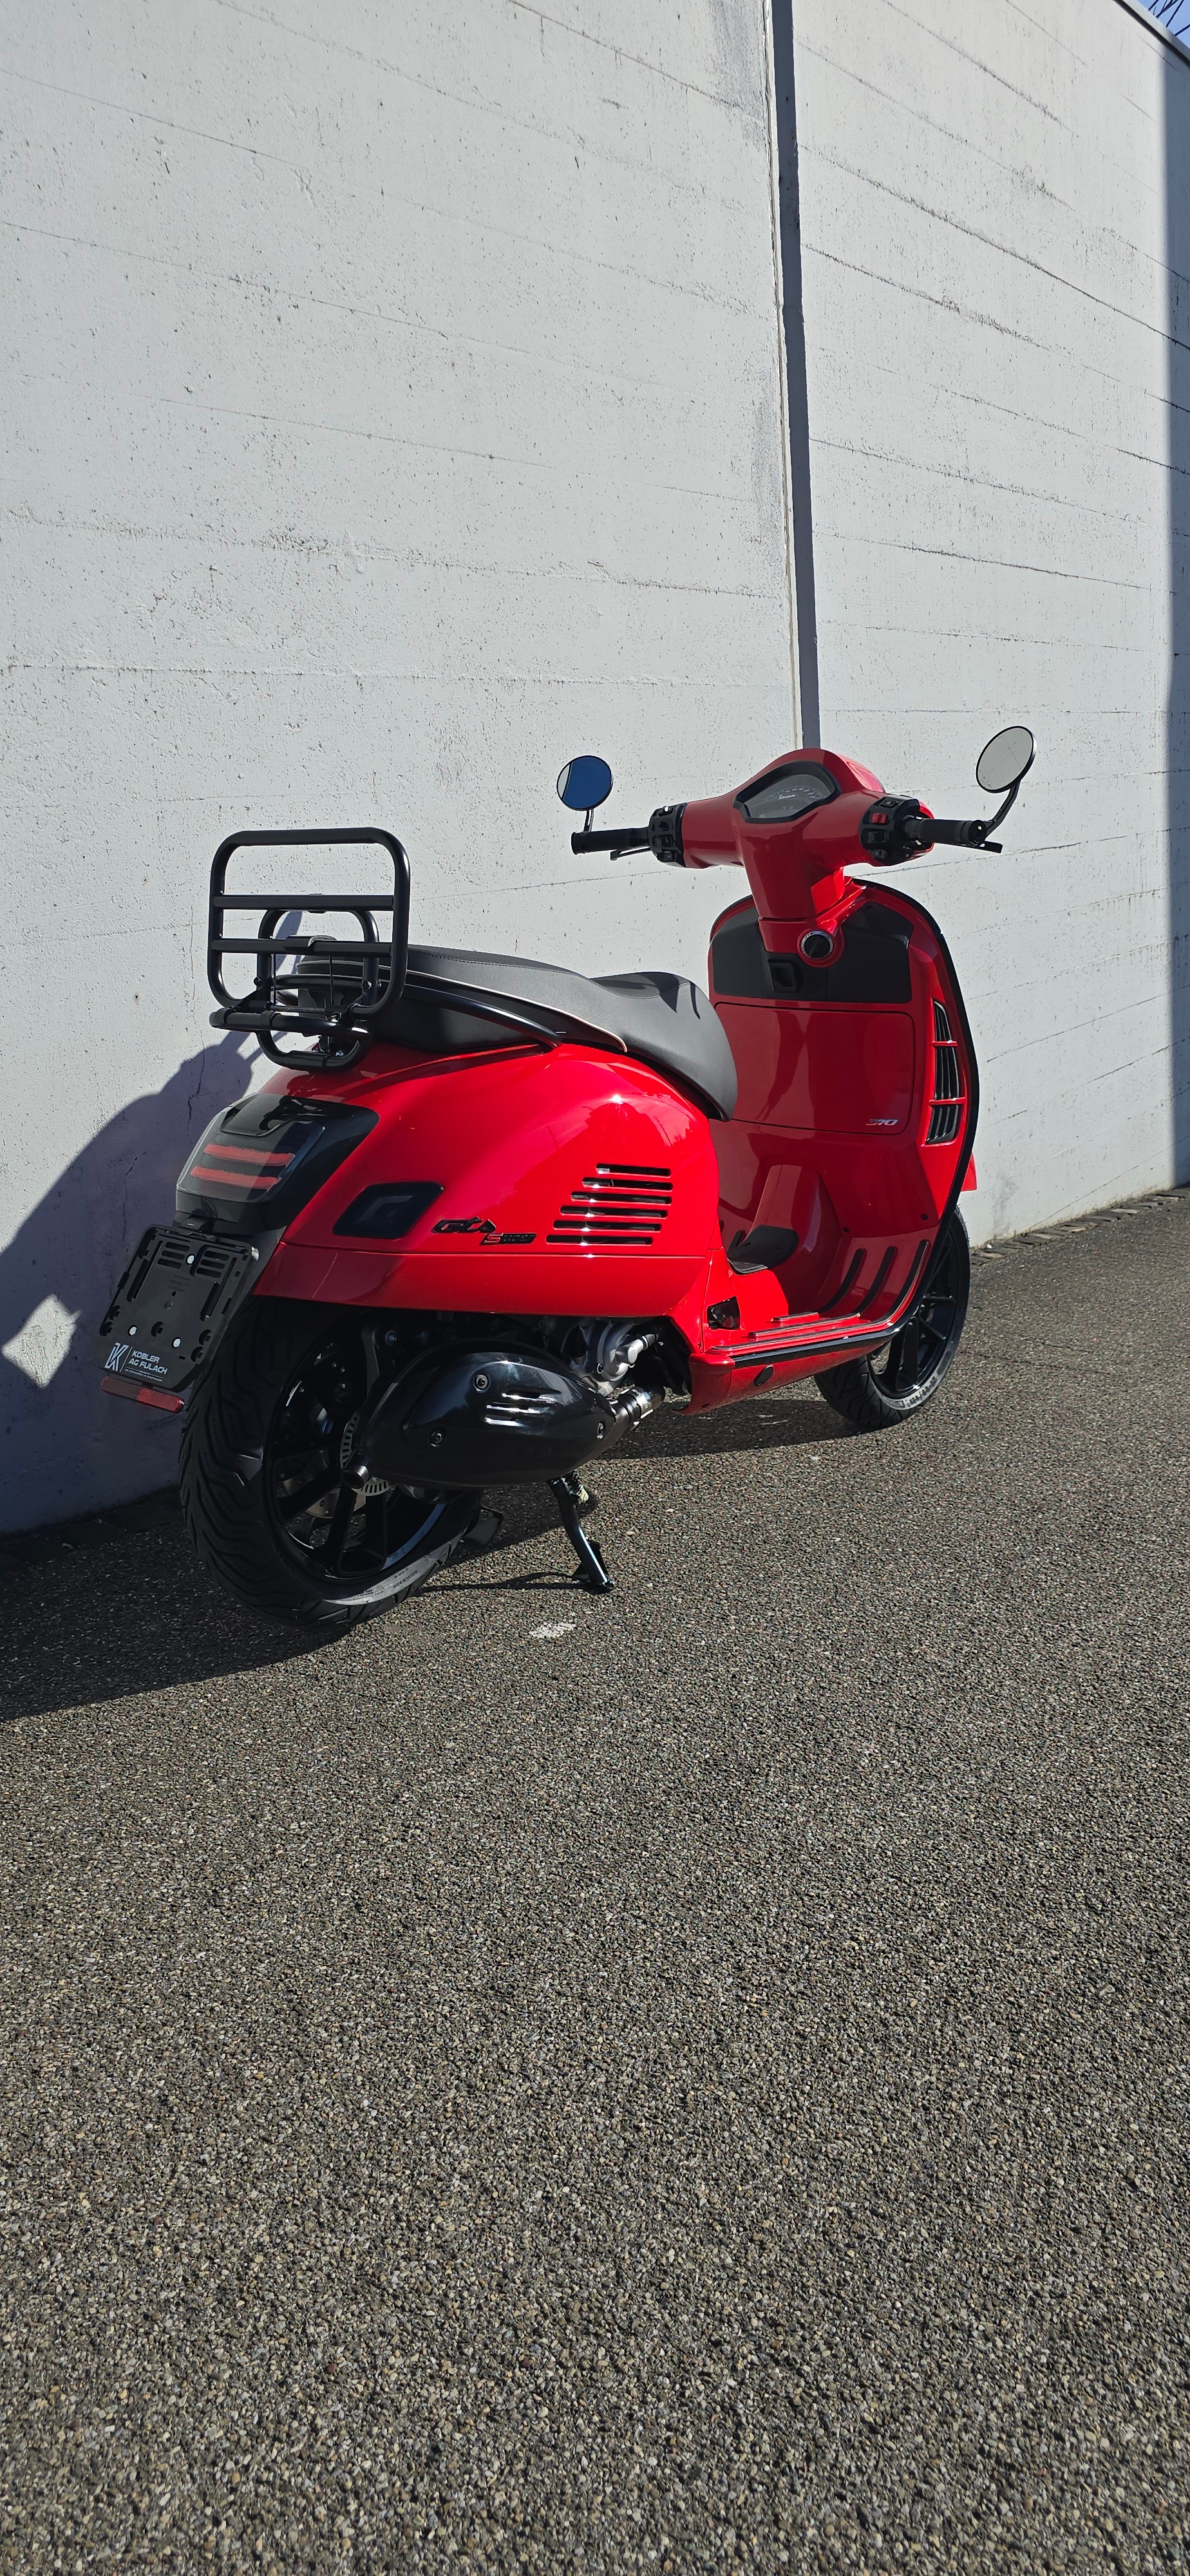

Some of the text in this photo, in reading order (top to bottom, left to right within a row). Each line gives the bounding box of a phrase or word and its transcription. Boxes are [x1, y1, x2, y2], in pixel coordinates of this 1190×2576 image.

[131, 1350, 160, 1363] KOBLER
[128, 1358, 140, 1366] AG
[139, 1361, 168, 1375] FULACH
